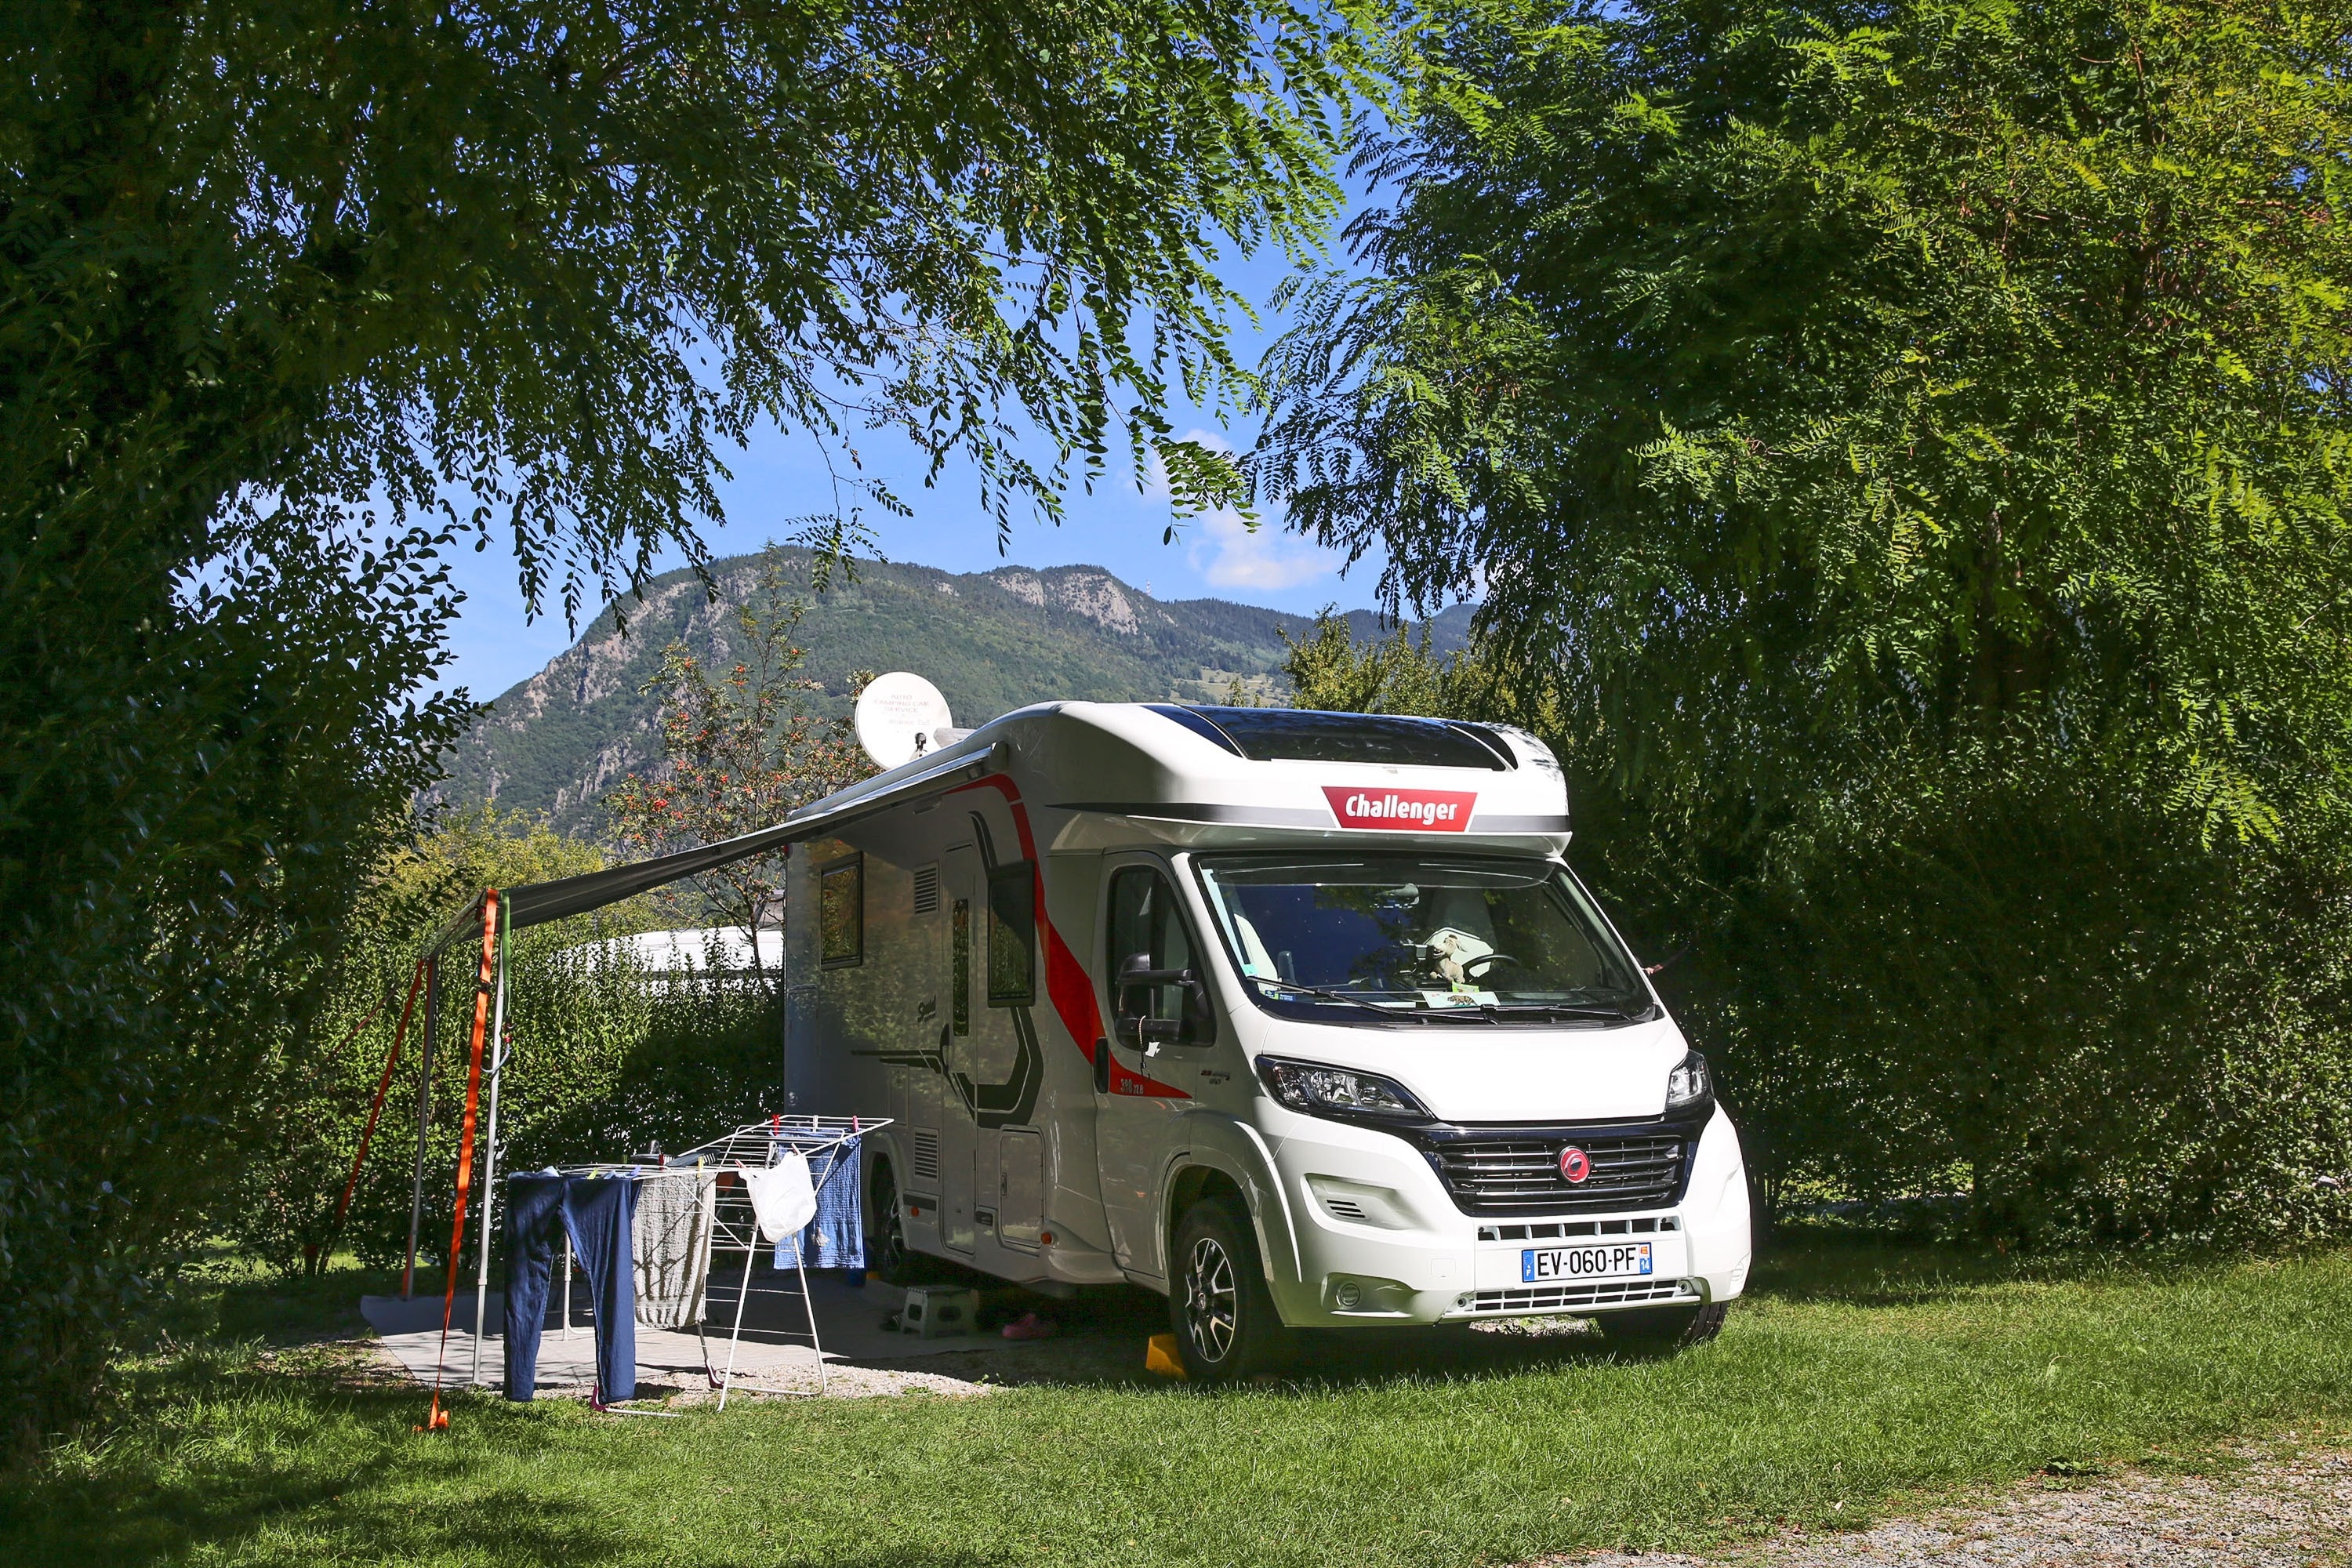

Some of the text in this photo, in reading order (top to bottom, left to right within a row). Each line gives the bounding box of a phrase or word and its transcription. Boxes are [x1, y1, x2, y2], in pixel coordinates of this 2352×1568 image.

[1345, 793, 1458, 826] Challenger
[1537, 1247, 1637, 1277] EV-060-PF
[1641, 1259, 1650, 1271] 14
[1526, 1269, 1531, 1277] F
